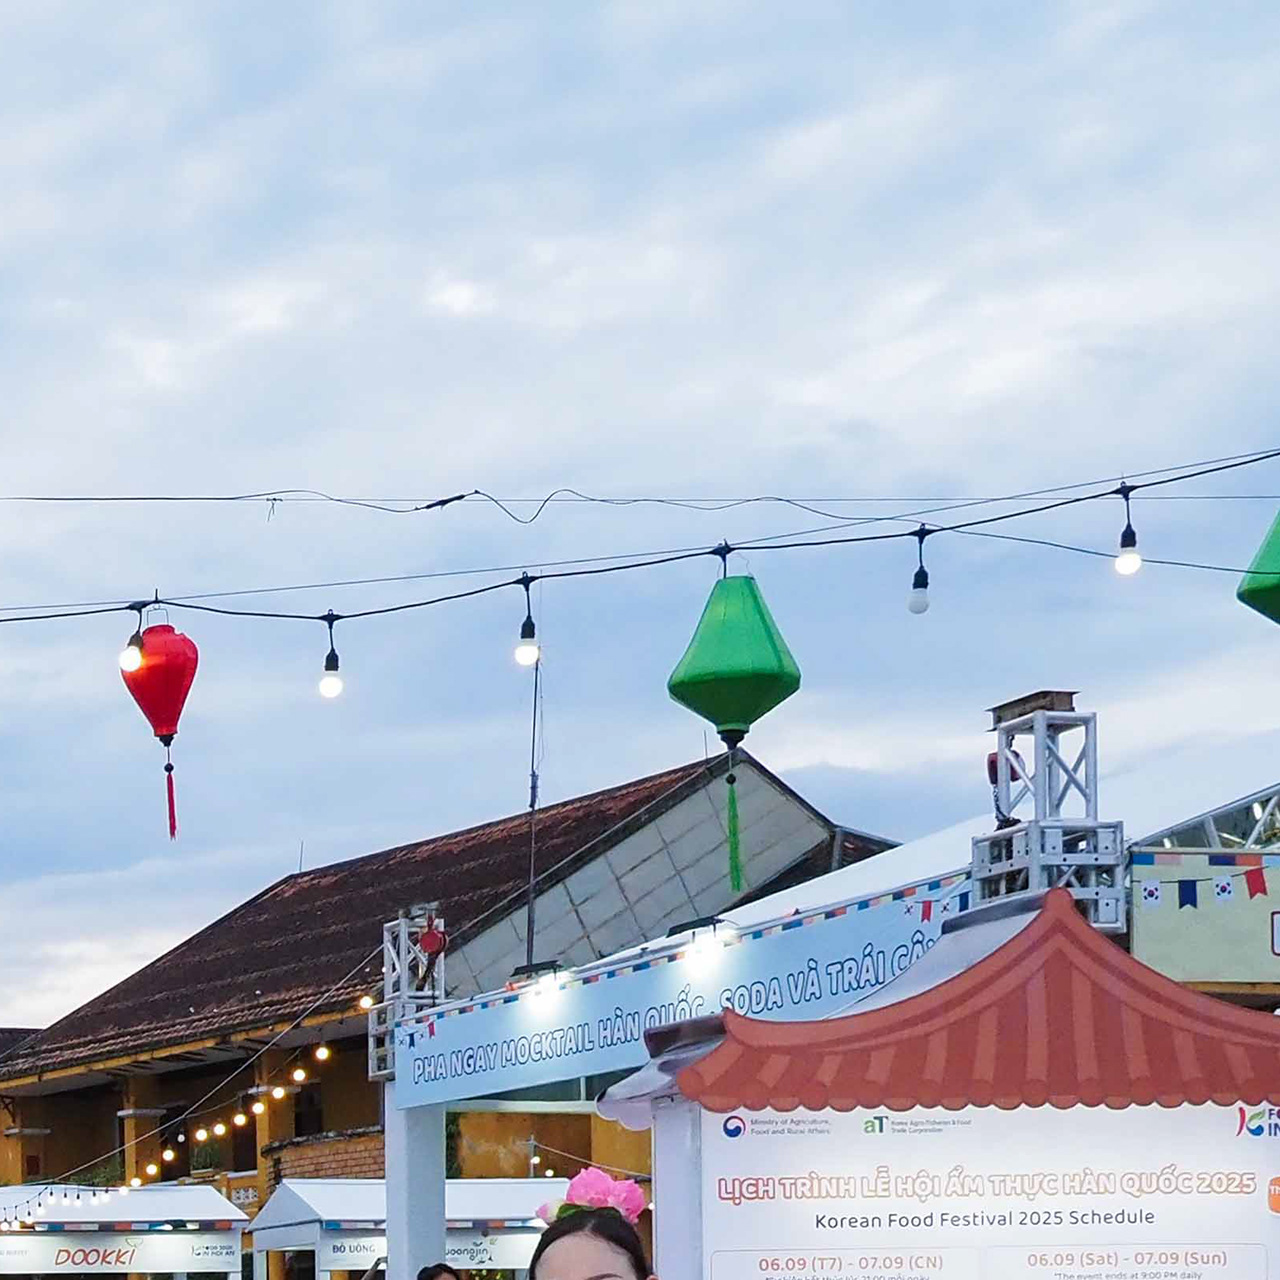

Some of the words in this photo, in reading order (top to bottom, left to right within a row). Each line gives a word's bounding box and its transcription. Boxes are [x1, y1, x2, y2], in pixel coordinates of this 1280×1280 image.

[413, 1054, 448, 1084] PHA
[450, 1042, 498, 1078] NGAY
[501, 1022, 595, 1068] MOCKTAIL
[597, 1006, 640, 1048] HÀN
[720, 976, 783, 1017] SODA
[787, 958, 822, 1005] VÀ
[826, 942, 886, 996] TRÁI
[891, 929, 935, 977] CÂ
[718, 1177, 775, 1206] LỊCH
[778, 1171, 856, 1199] TRÌNH
[861, 1166, 890, 1198] LỄ
[895, 1169, 940, 1203] HỘI
[990, 1173, 1058, 1201] THỰC
[1063, 1168, 1116, 1196] HÀN
[1121, 1164, 1192, 1197] QUỐC
[1196, 1172, 1257, 1195] 2025
[816, 1213, 882, 1229] Korean
[888, 1211, 934, 1228] Food
[940, 1210, 1013, 1227] Festival
[1018, 1210, 1064, 1226] 2025
[1069, 1209, 1155, 1225] Schedule
[54, 1248, 135, 1265] DOOKKI
[758, 1257, 807, 1272] 06.09
[811, 1256, 843, 1273] (T7)
[858, 1256, 903, 1270] 07.09
[908, 1255, 943, 1271] (CN)
[1027, 1253, 1075, 1267] 06.09
[1079, 1251, 1119, 1267] (Sat)
[1134, 1252, 1180, 1265] 07.09
[1184, 1251, 1228, 1267] (Sun)
[1076, 1273, 1103, 1280] event
[1105, 1272, 1128, 1280] ends
[1130, 1272, 1139, 1280] at
[1164, 1271, 1178, 1280] PM
[1180, 1271, 1202, 1280] daily
